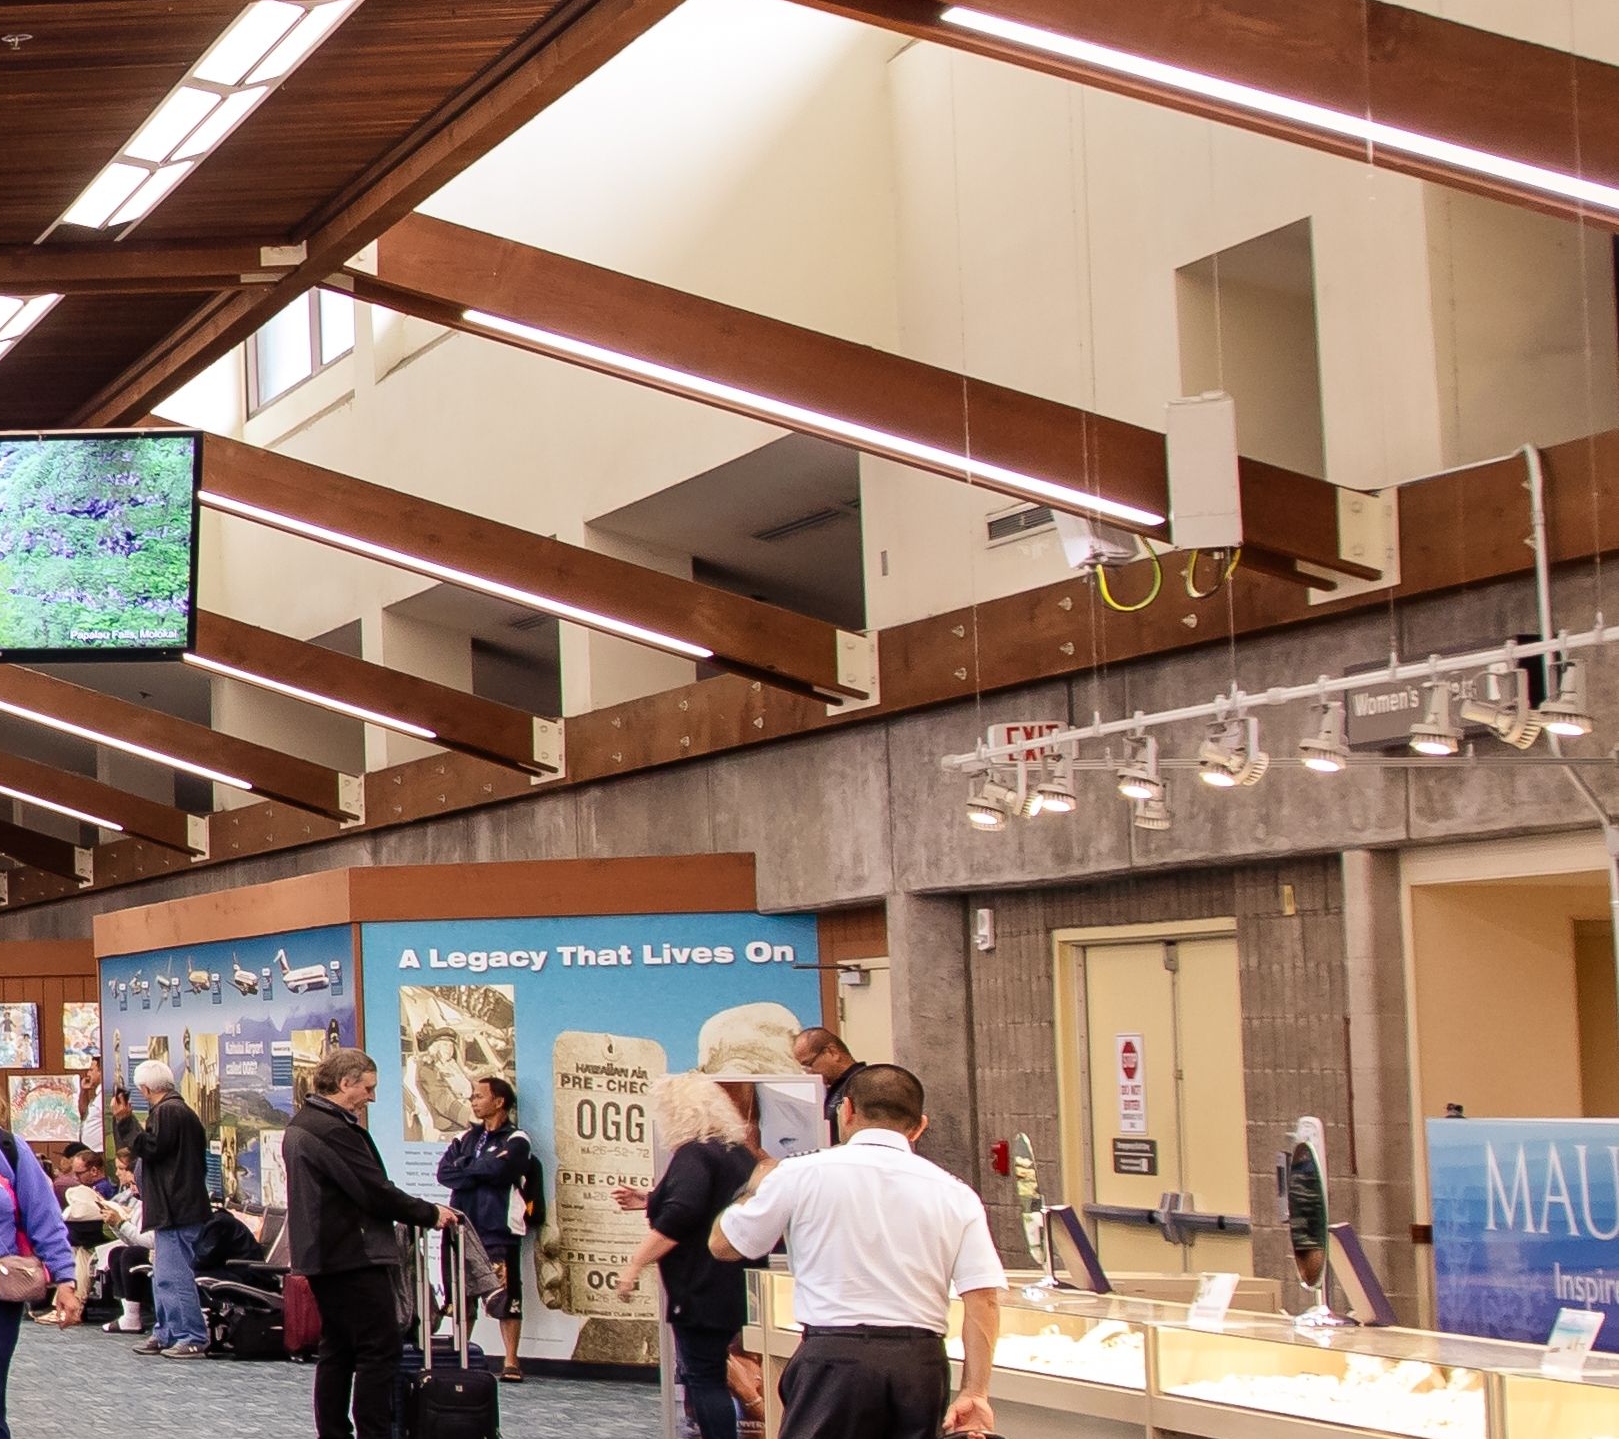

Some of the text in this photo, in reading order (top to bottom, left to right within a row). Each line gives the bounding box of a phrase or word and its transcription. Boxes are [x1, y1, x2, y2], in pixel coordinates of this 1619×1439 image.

[1353, 685, 1420, 717] Women's
[399, 941, 795, 972] A Legacy That Lives On
[577, 1099, 645, 1143] OGG
